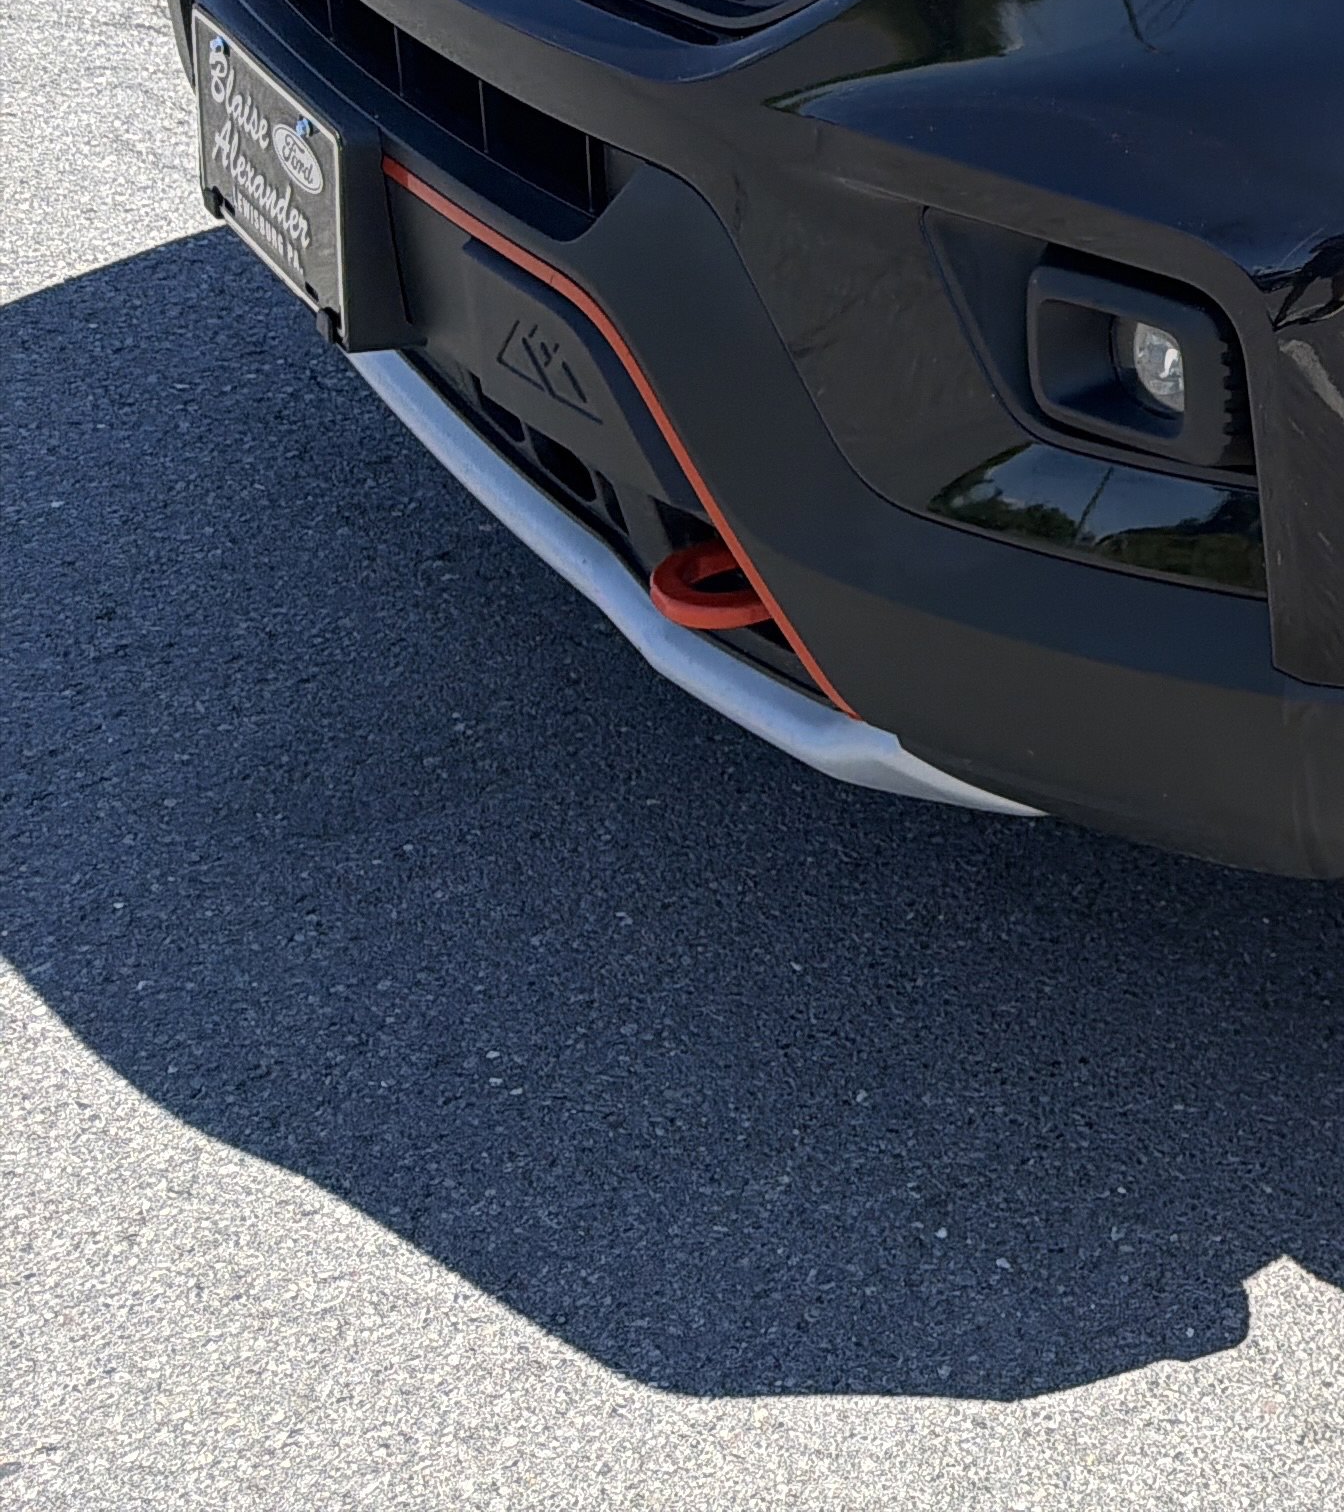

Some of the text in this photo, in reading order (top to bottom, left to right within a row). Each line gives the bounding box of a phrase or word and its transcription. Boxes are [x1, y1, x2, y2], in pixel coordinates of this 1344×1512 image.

[209, 41, 270, 150] Blaise
[212, 120, 310, 249] Alexander
[281, 133, 315, 186] Ford
[231, 187, 285, 258] LEWISBURG
